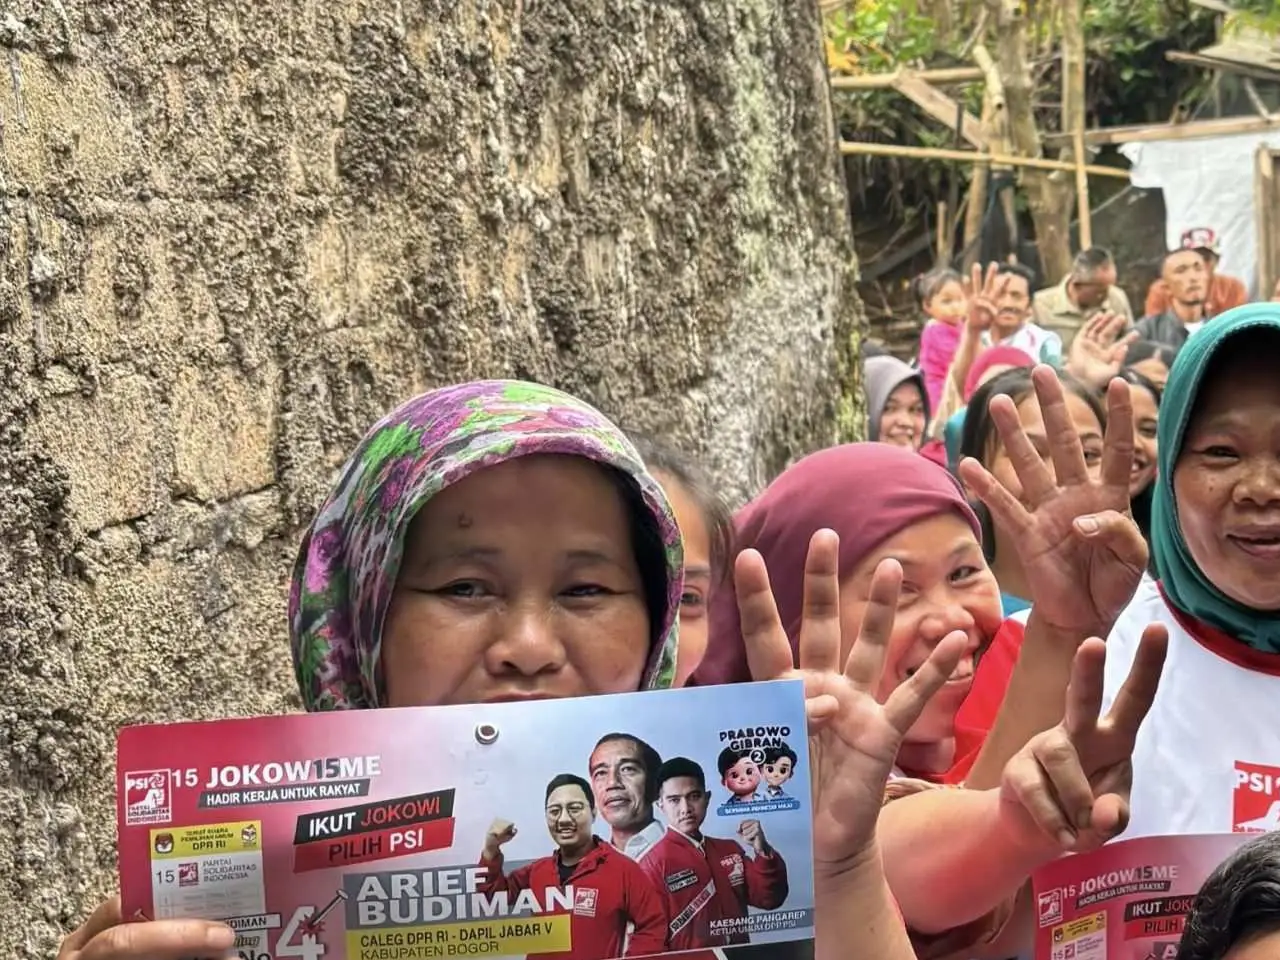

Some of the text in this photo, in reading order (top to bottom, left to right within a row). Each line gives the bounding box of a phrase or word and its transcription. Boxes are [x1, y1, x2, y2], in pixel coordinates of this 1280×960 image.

[719, 726, 791, 741] PRABOWO
[730, 737, 782, 751] GIBRAN
[171, 768, 198, 787] 15
[206, 755, 381, 788] JOKOW15ME
[127, 777, 148, 790] PSI
[1235, 769, 1272, 795] PSI
[207, 782, 361, 806] HADIR KERJA UNTUK RAKYAT
[309, 797, 440, 837] IKUT JOKOWI
[329, 829, 423, 862] PILIH PSI
[156, 869, 175, 884] 15
[203, 862, 257, 875] SOLIDARITAS
[203, 871, 249, 883] INDONESIA
[357, 867, 489, 901] ARIEF
[1063, 887, 1076, 899] 15
[358, 885, 574, 926] BUDIMAN
[1132, 899, 1192, 916] IKUT JOK
[224, 915, 267, 930] DIMAN
[710, 910, 806, 929] KAESANG PANGAREP
[1144, 920, 1178, 934] PILIH
[360, 932, 403, 947] CALEG
[407, 931, 434, 946] DPR
[436, 929, 449, 943] RI
[460, 927, 496, 941] DAPIL
[499, 923, 541, 938] JABAR
[544, 922, 553, 934] V
[361, 942, 499, 960] KABUPATEN BOGOR
